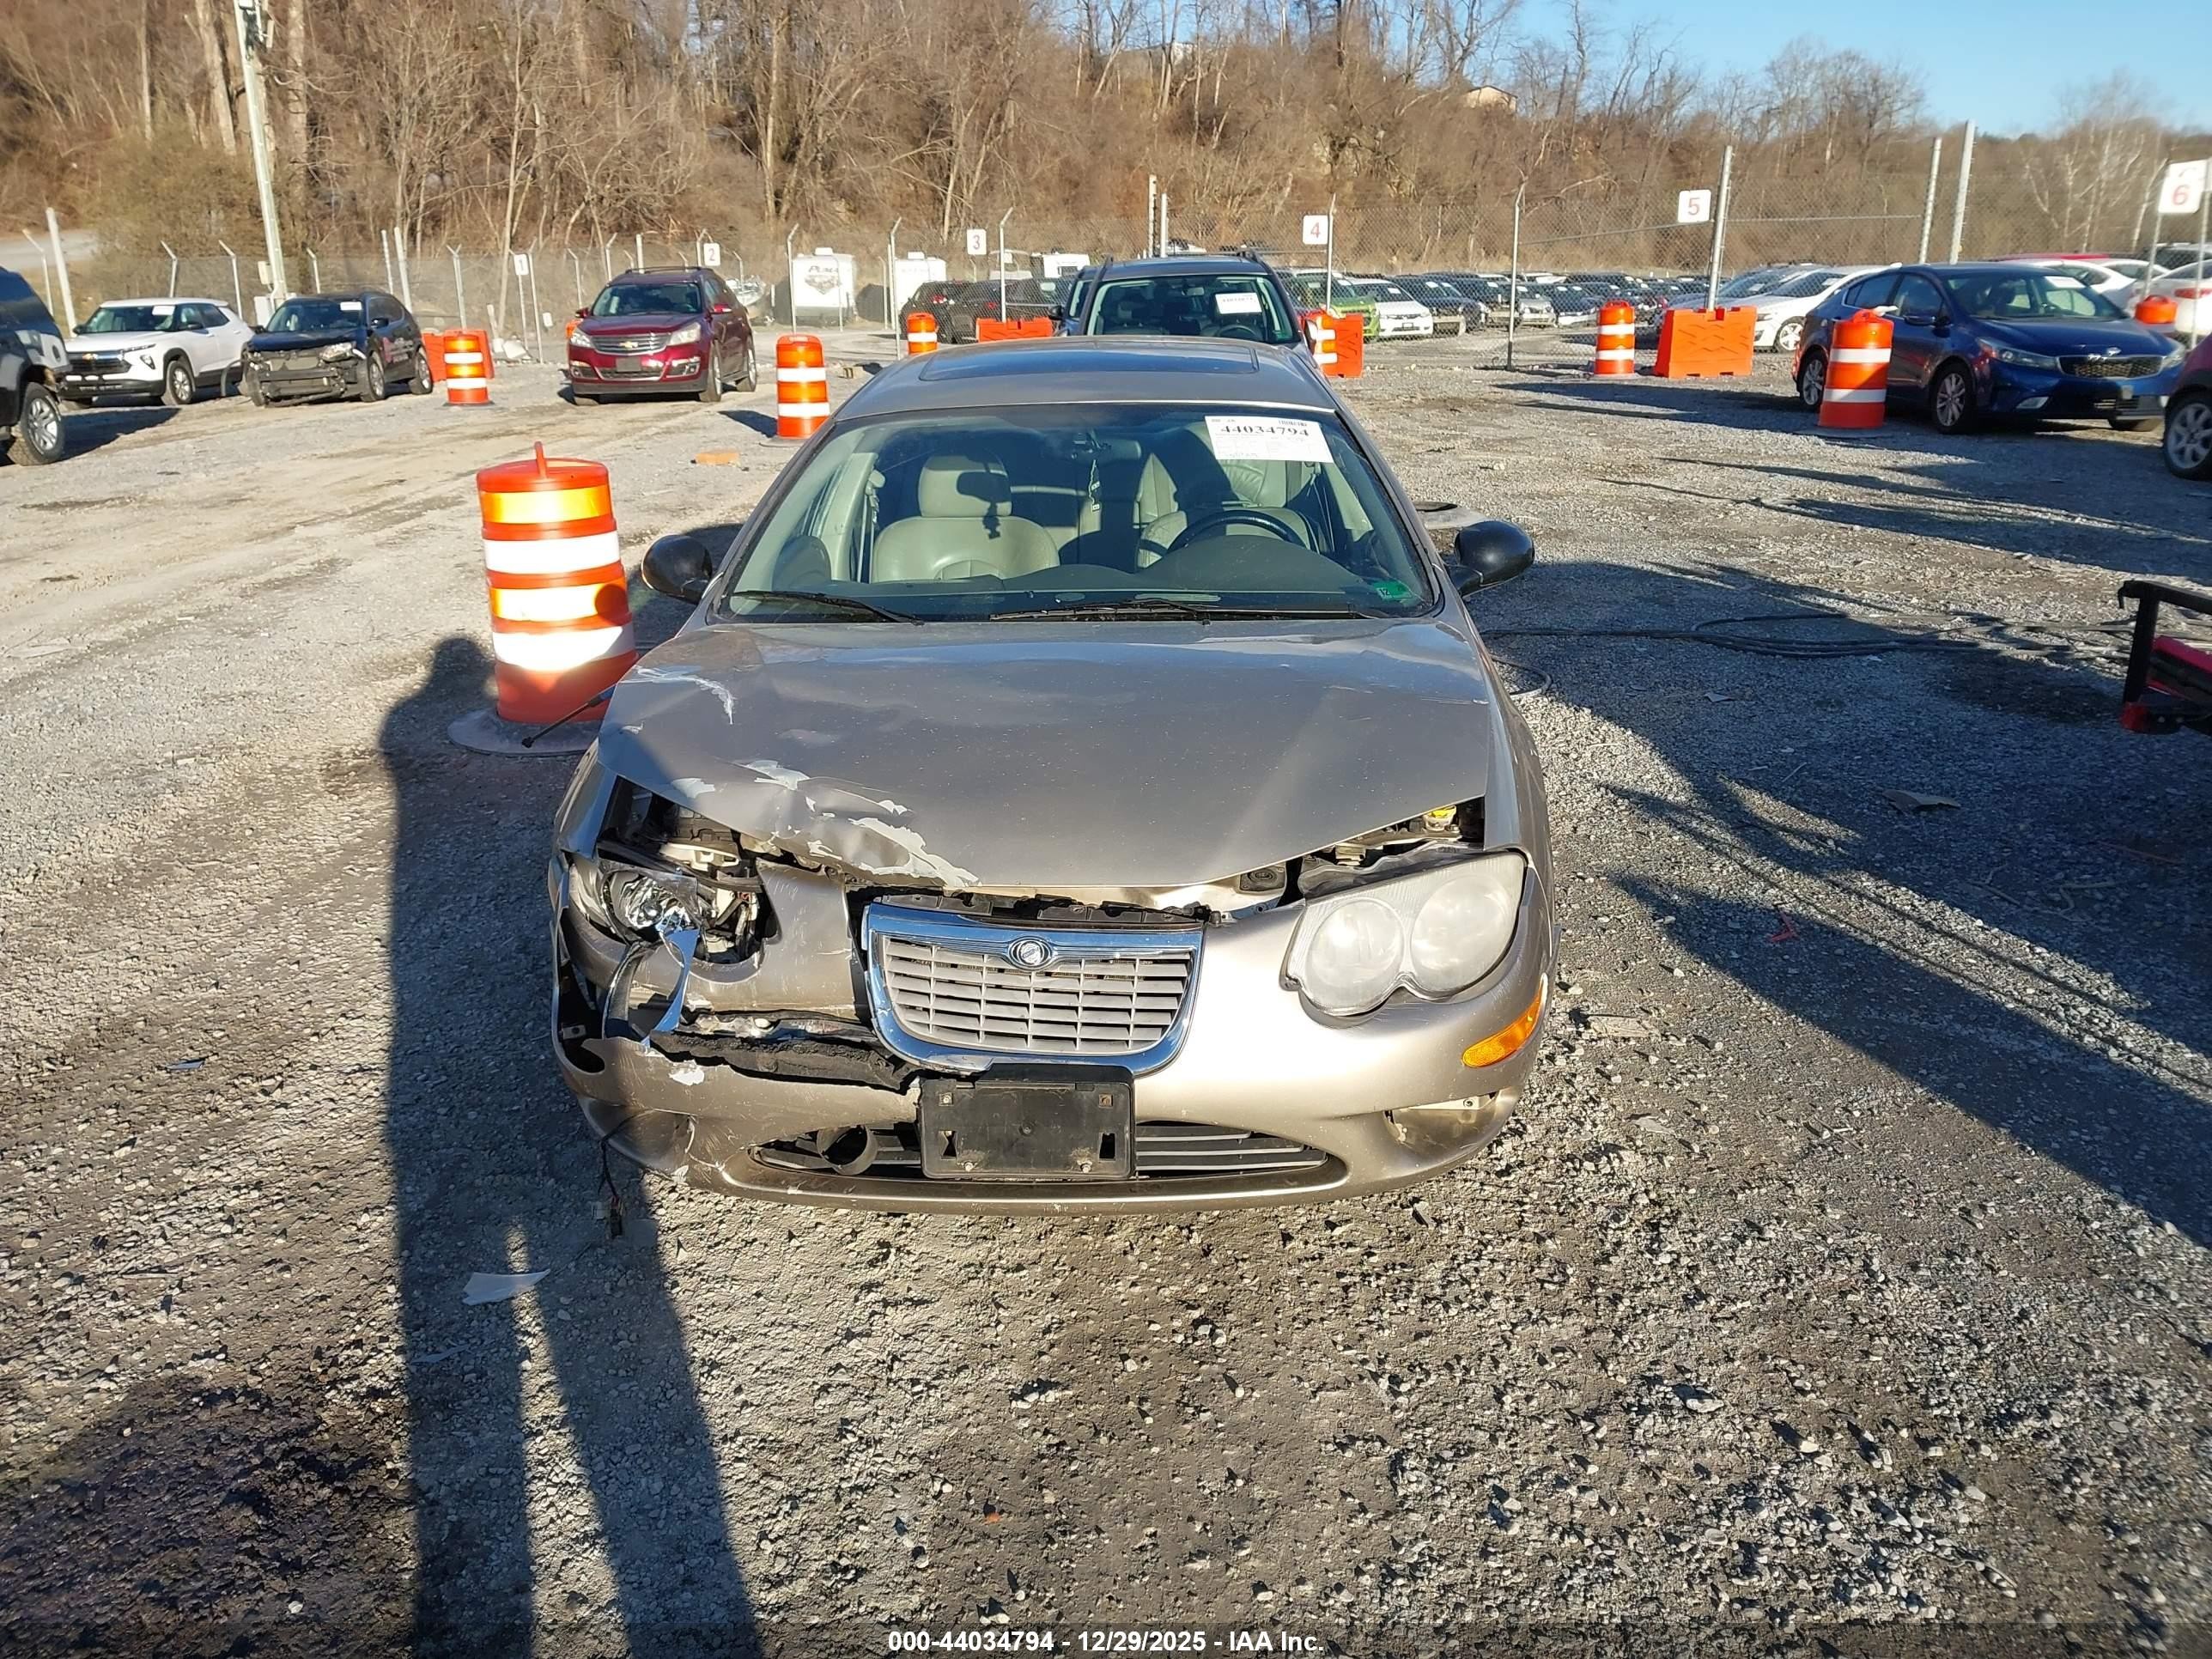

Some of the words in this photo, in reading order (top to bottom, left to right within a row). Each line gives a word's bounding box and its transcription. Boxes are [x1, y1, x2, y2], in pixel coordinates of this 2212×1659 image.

[2172, 184, 2190, 206] 6
[1688, 198, 1700, 216] 5
[1310, 222, 1321, 239] 4
[973, 234, 980, 250] 3
[708, 247, 715, 261] 2
[1220, 425, 1310, 436] 44034794
